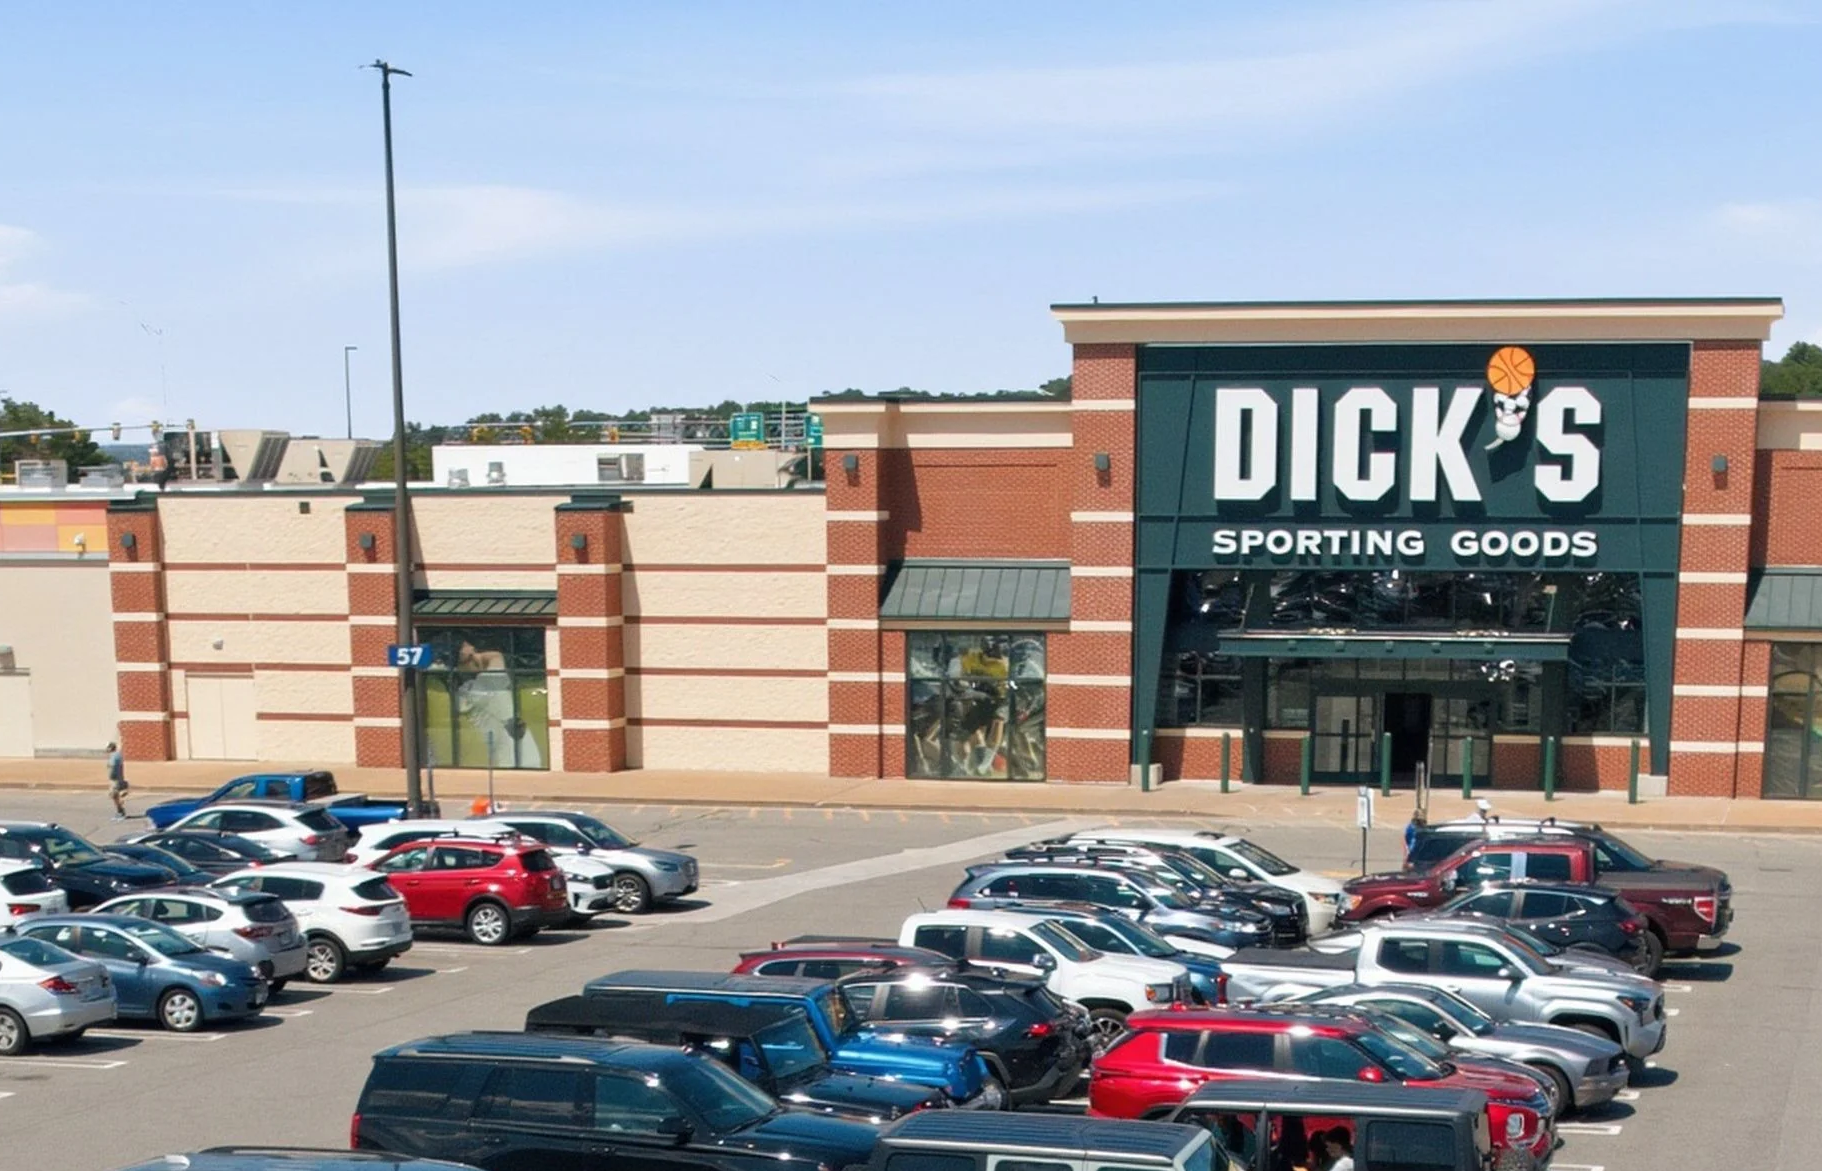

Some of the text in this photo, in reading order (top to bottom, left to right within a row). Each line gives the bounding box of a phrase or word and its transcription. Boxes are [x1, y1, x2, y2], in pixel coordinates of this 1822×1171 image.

[1214, 346, 1602, 502] DICK'S
[1212, 530, 1598, 557] SPORTING GOODS
[397, 647, 424, 665] 57
